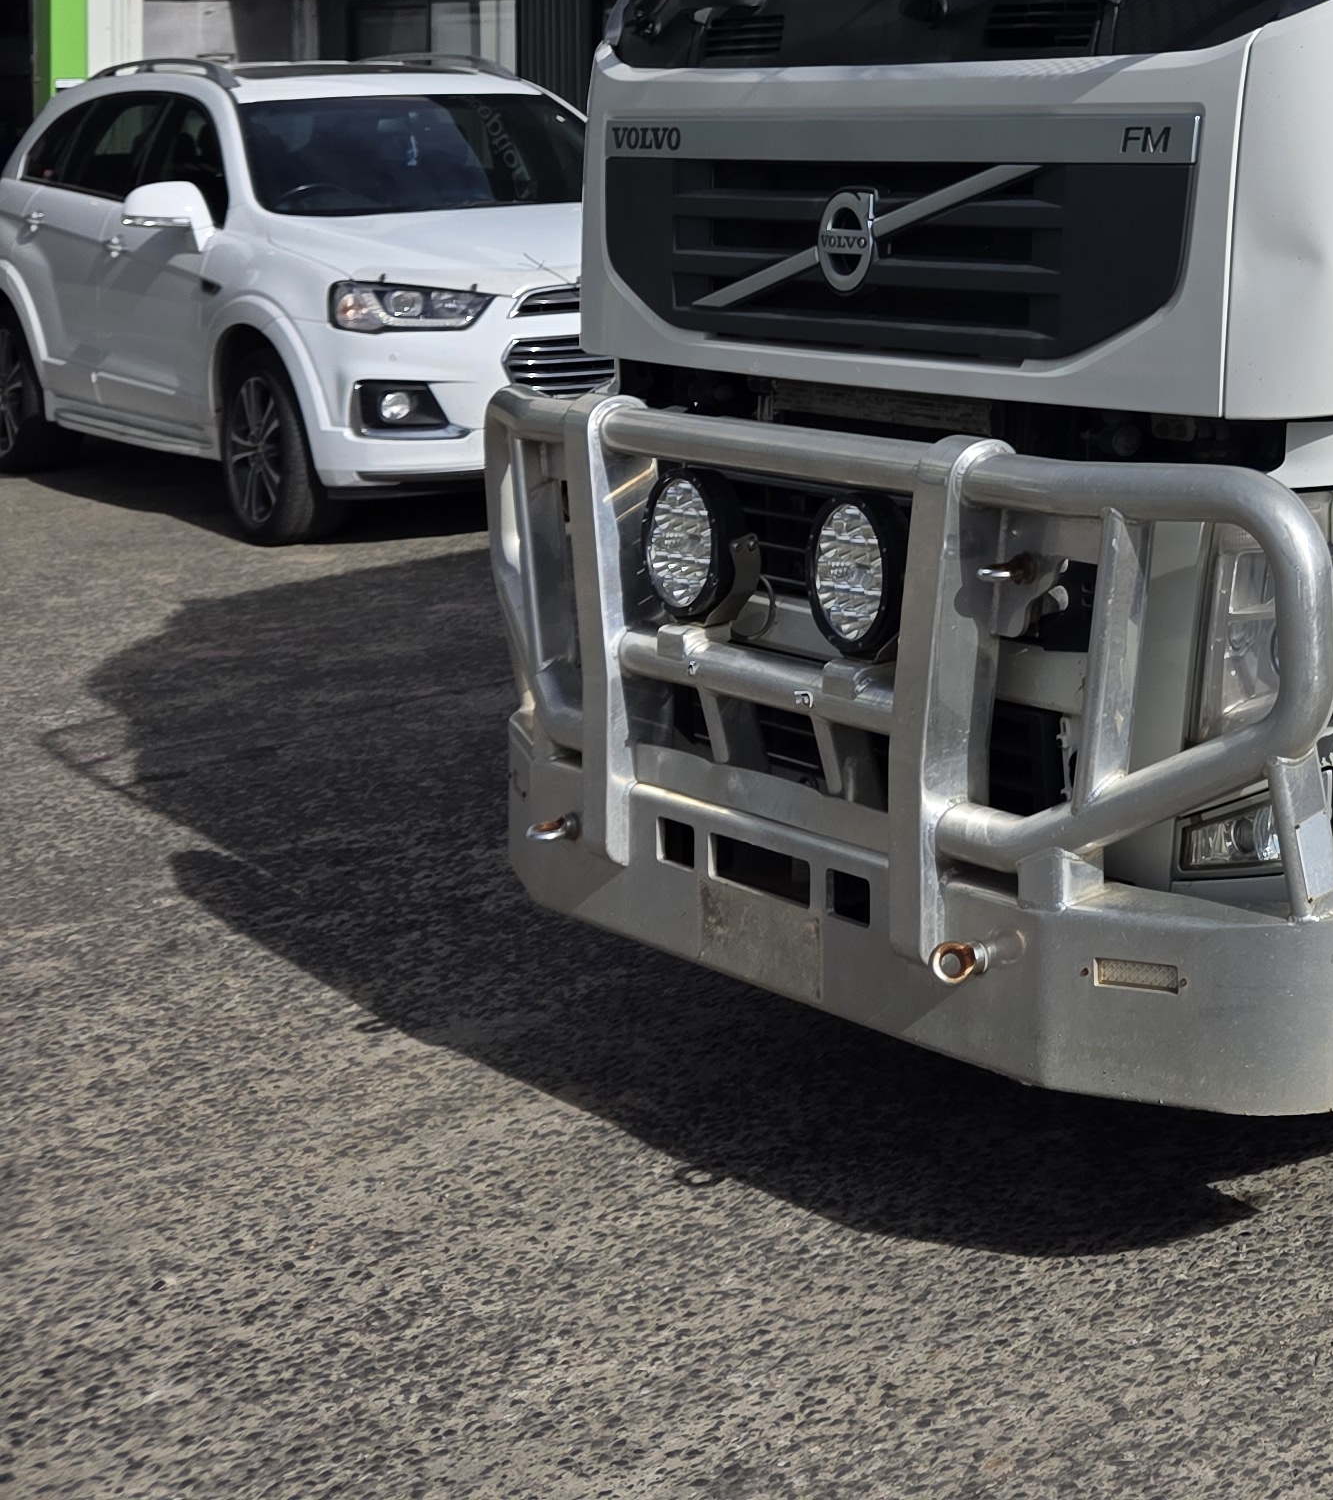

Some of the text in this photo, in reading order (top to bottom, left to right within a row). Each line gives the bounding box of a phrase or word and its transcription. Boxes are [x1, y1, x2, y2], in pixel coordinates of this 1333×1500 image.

[611, 126, 682, 152] VOLVO
[1120, 126, 1172, 154] FM
[819, 232, 868, 251] VOLVO
